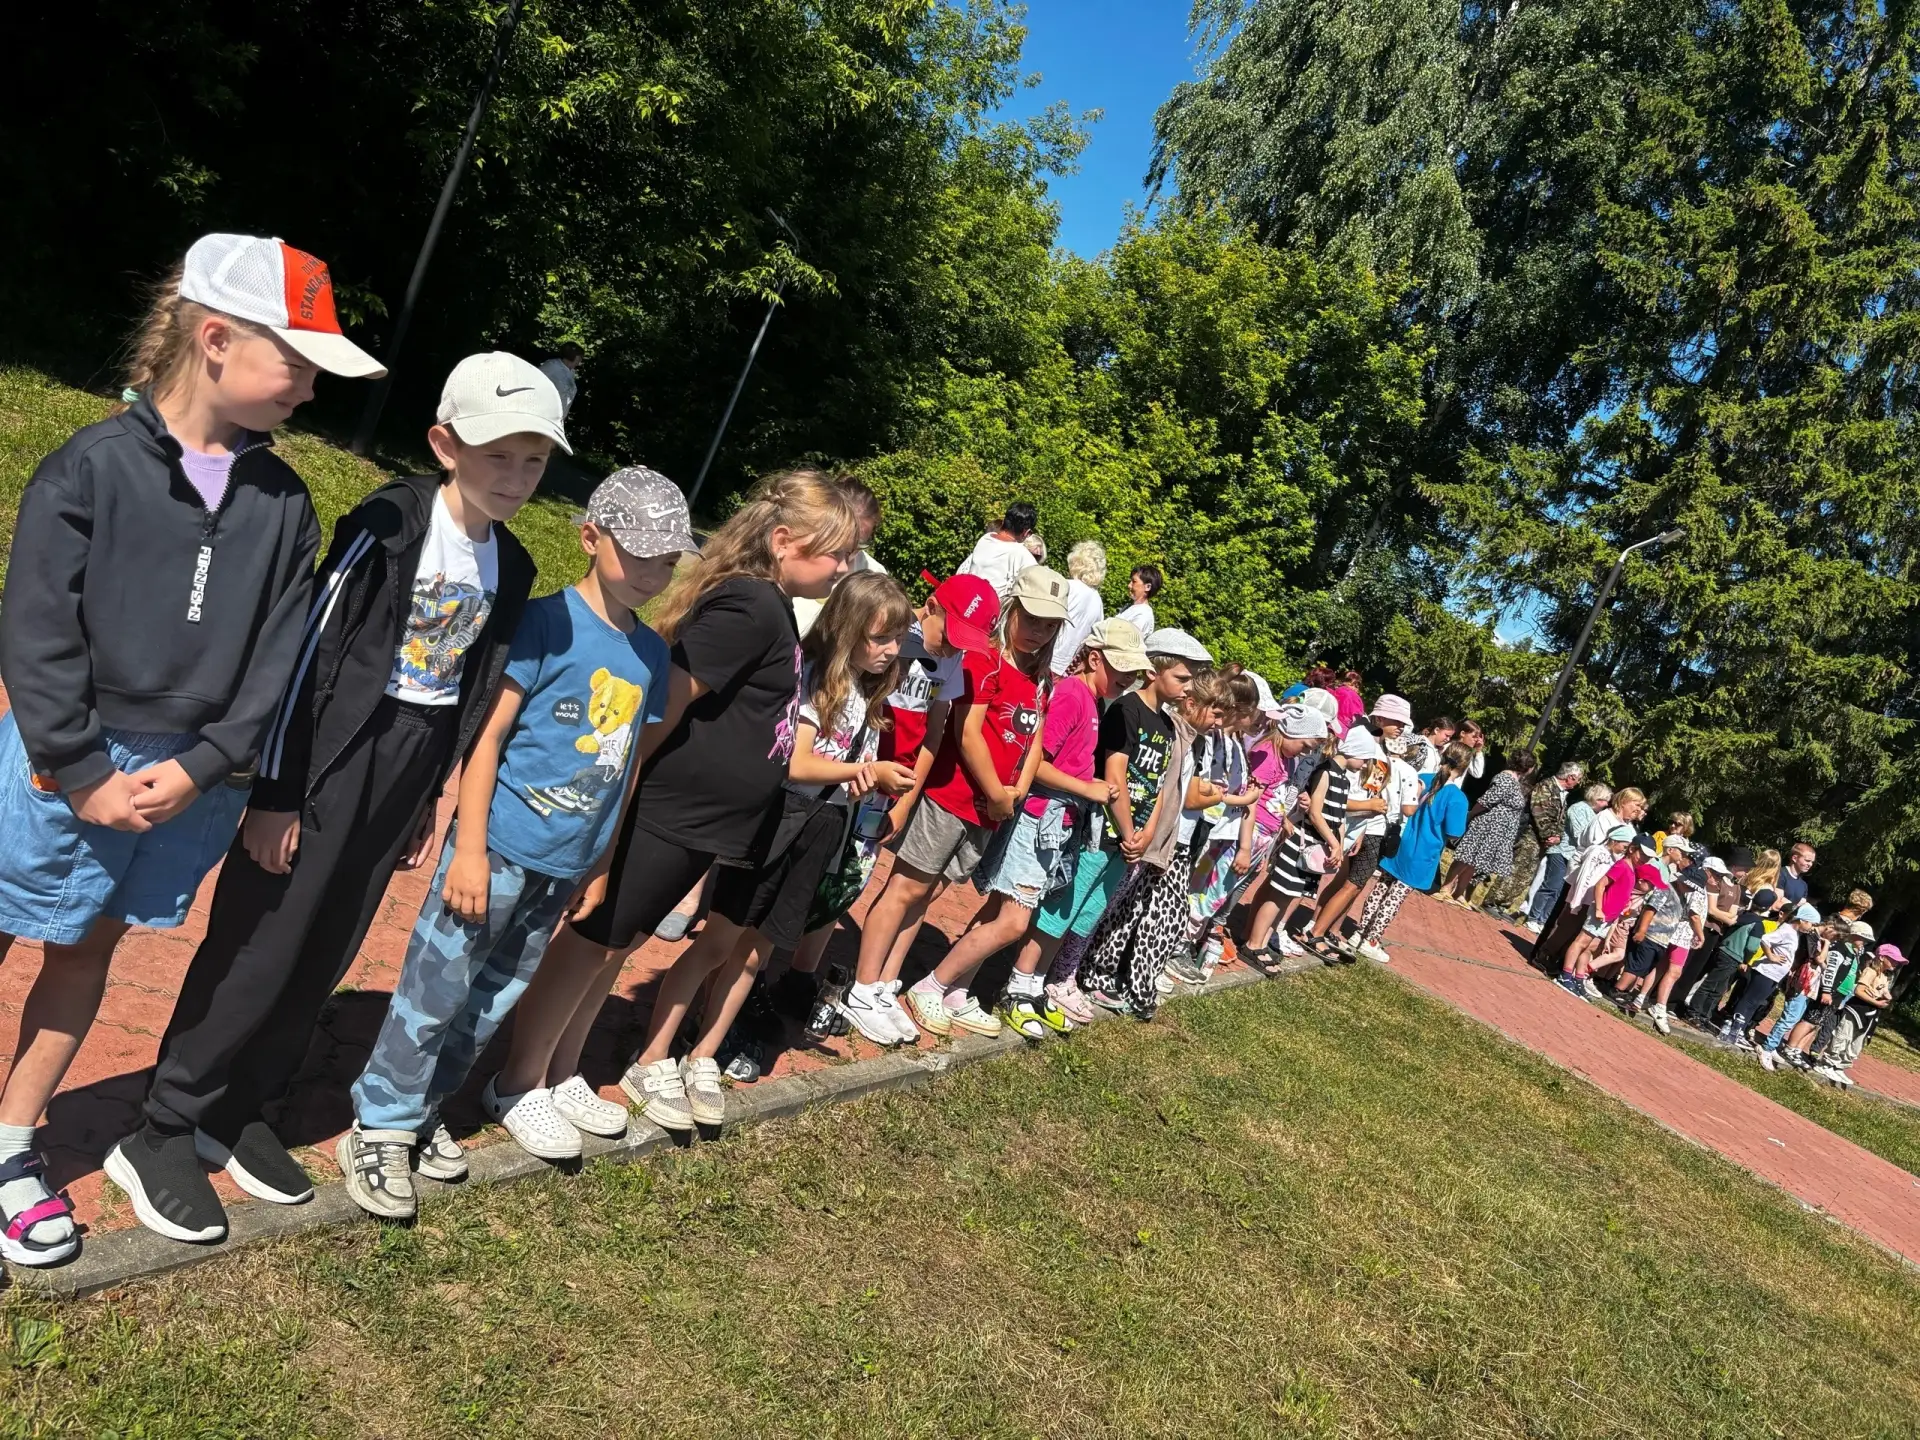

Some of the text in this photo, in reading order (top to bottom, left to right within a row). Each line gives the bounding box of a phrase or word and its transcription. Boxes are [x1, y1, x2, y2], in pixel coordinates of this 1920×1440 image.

[560, 703, 579, 711] let's
[555, 711, 579, 719] move
[1151, 731, 1165, 744] in
[1135, 744, 1163, 772] THE
